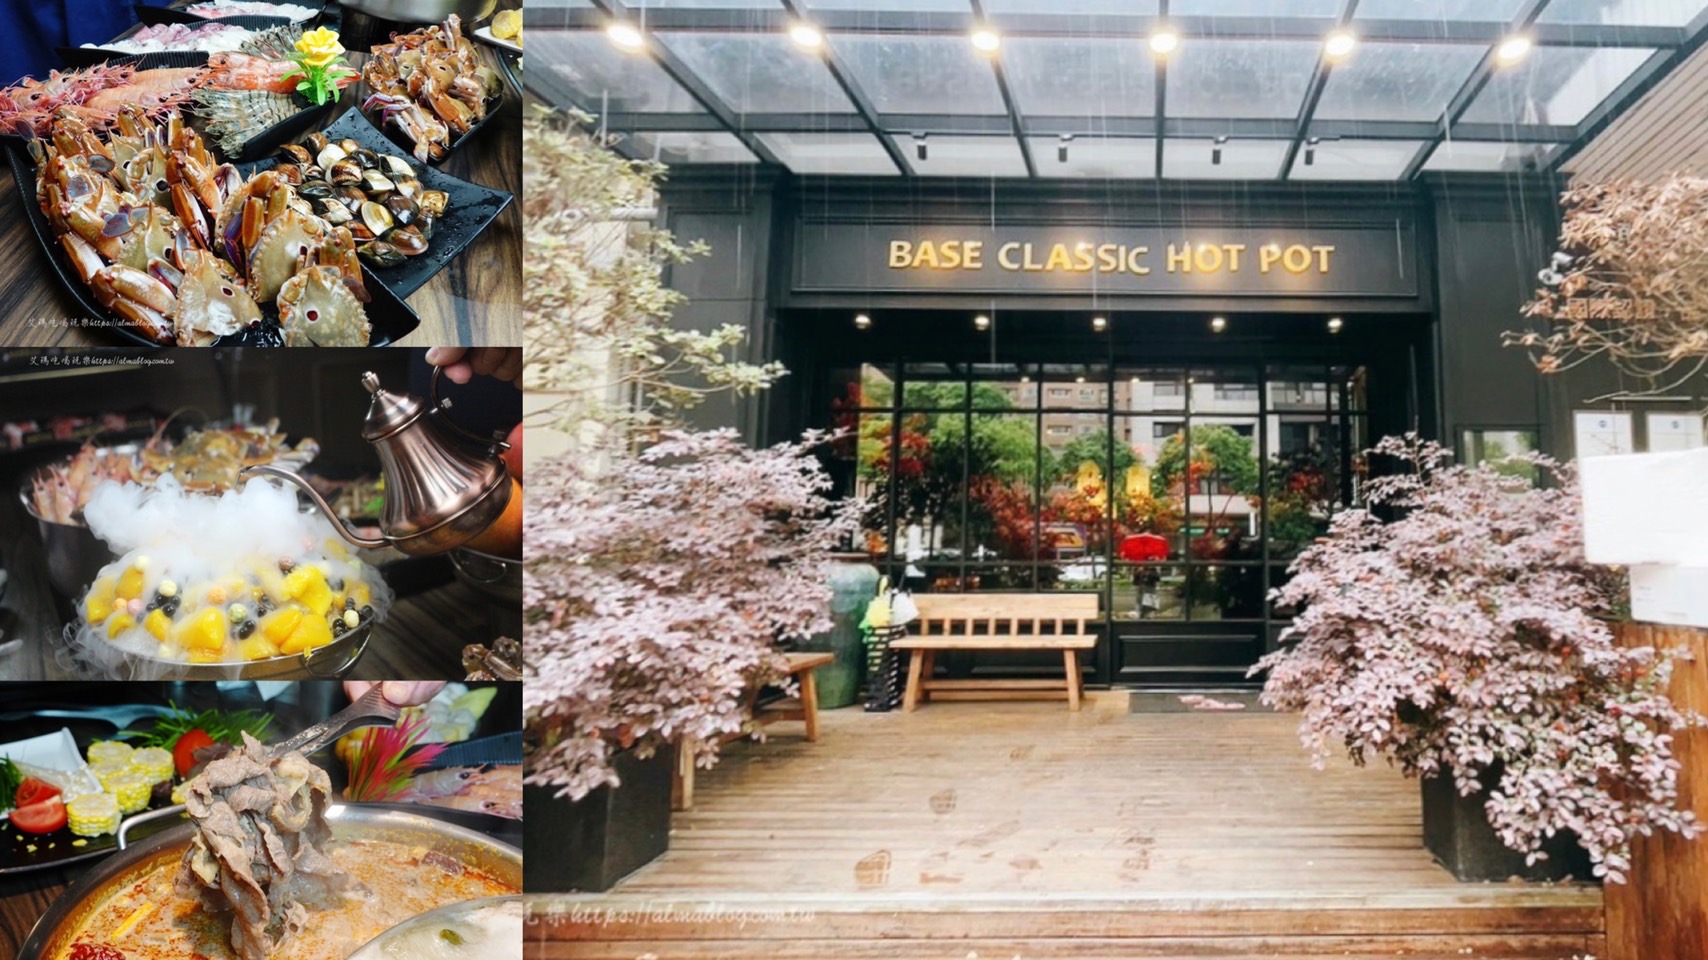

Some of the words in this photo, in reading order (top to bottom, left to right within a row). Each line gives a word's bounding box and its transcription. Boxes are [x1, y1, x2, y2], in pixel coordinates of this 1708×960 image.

[888, 240, 983, 269] BASE
[997, 241, 1151, 274] CLASSIC
[1166, 242, 1246, 273] HOT
[1259, 244, 1336, 273] POT
